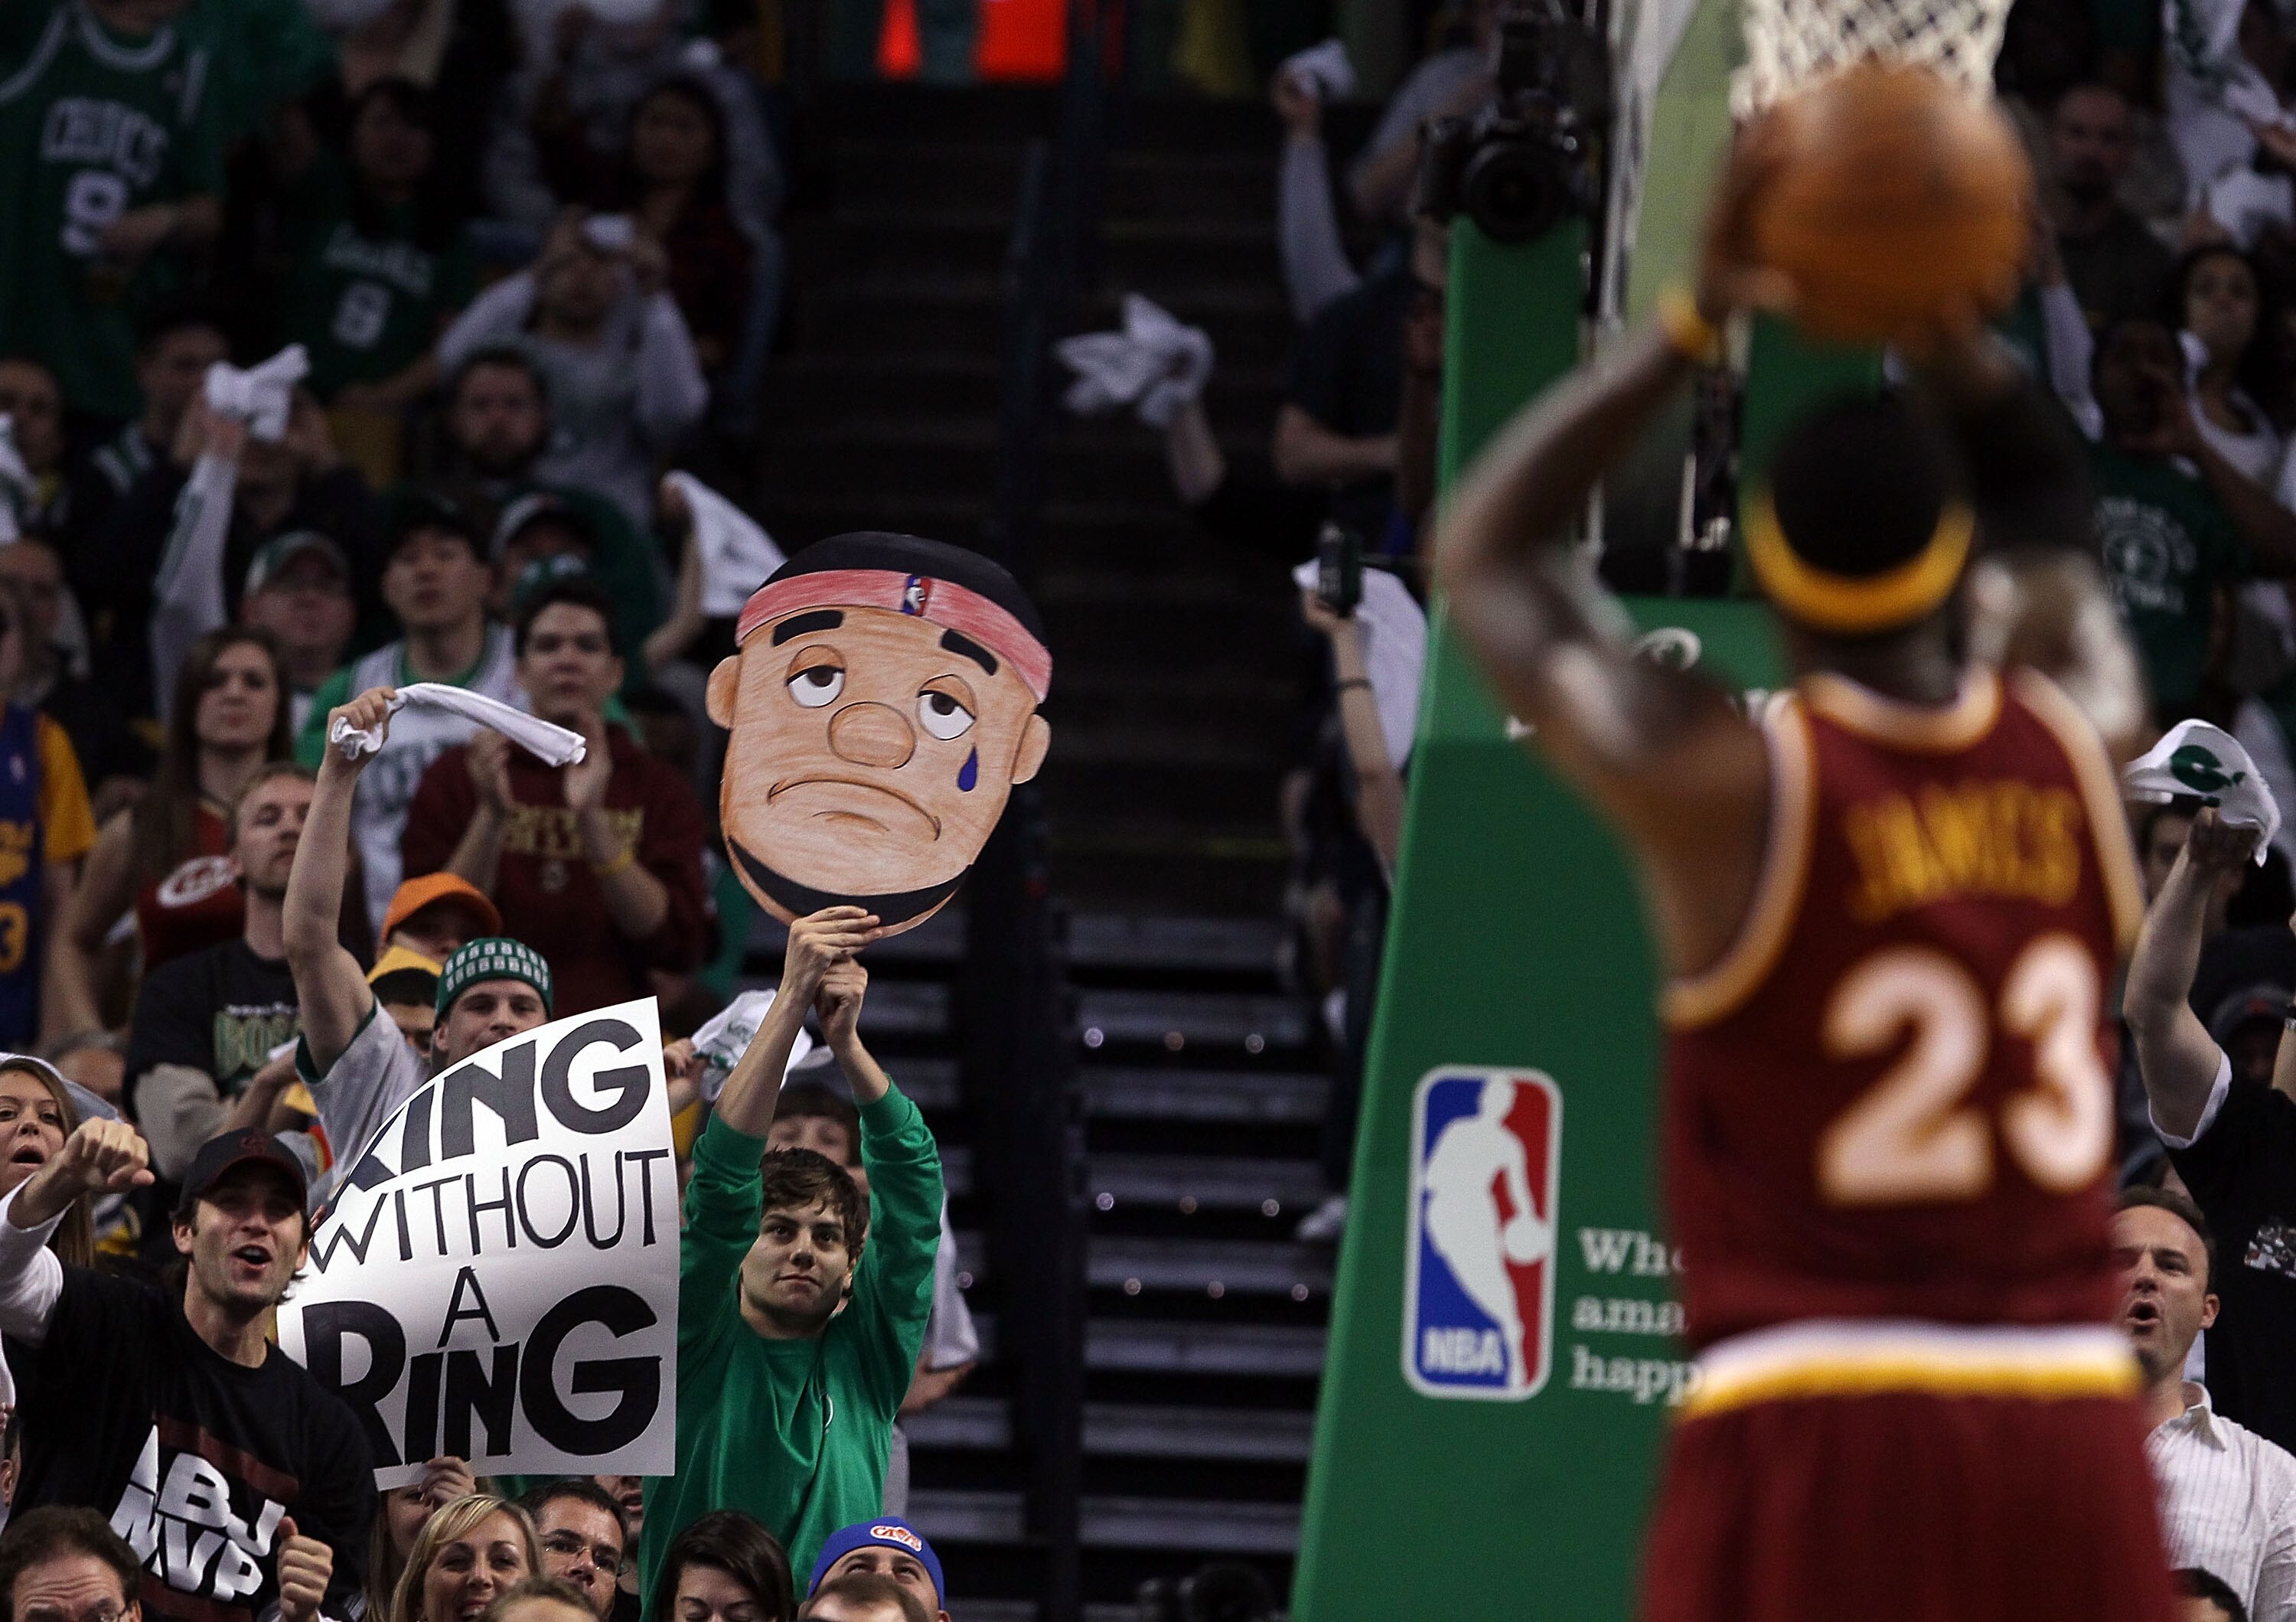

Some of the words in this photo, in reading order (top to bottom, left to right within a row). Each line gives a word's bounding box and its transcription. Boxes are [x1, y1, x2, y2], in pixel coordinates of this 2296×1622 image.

[1844, 779, 2082, 920] JAMES
[1815, 934, 2117, 1203] 23
[309, 1147, 669, 1274] WITHOUT
[437, 1265, 500, 1348] A
[1424, 1327, 1504, 1376] NBA
[302, 1284, 662, 1467] RING
[109, 1483, 264, 1602] MVP
